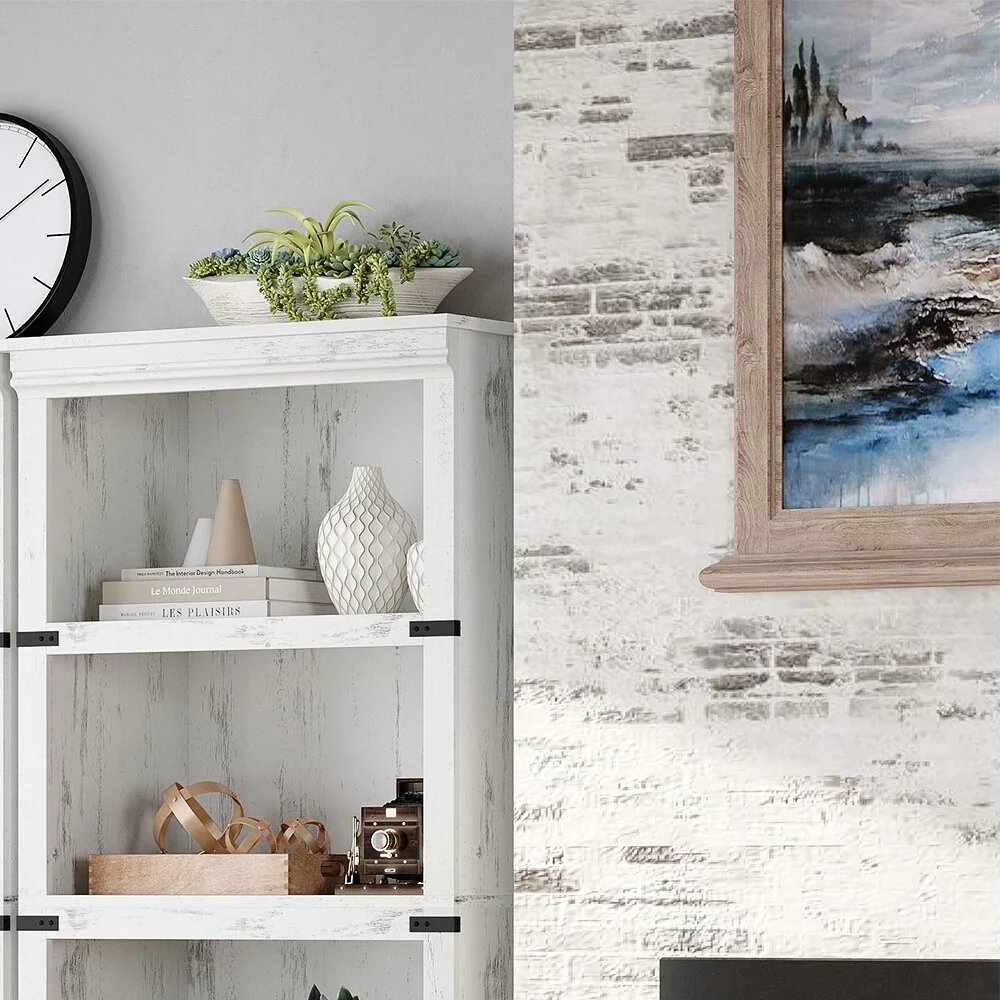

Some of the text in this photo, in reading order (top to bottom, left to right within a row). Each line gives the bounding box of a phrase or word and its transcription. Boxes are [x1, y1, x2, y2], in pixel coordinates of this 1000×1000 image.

[196, 569, 215, 577] Design
[151, 584, 221, 596] Le Monde Journal
[162, 606, 241, 618] LES PLAISIRS
